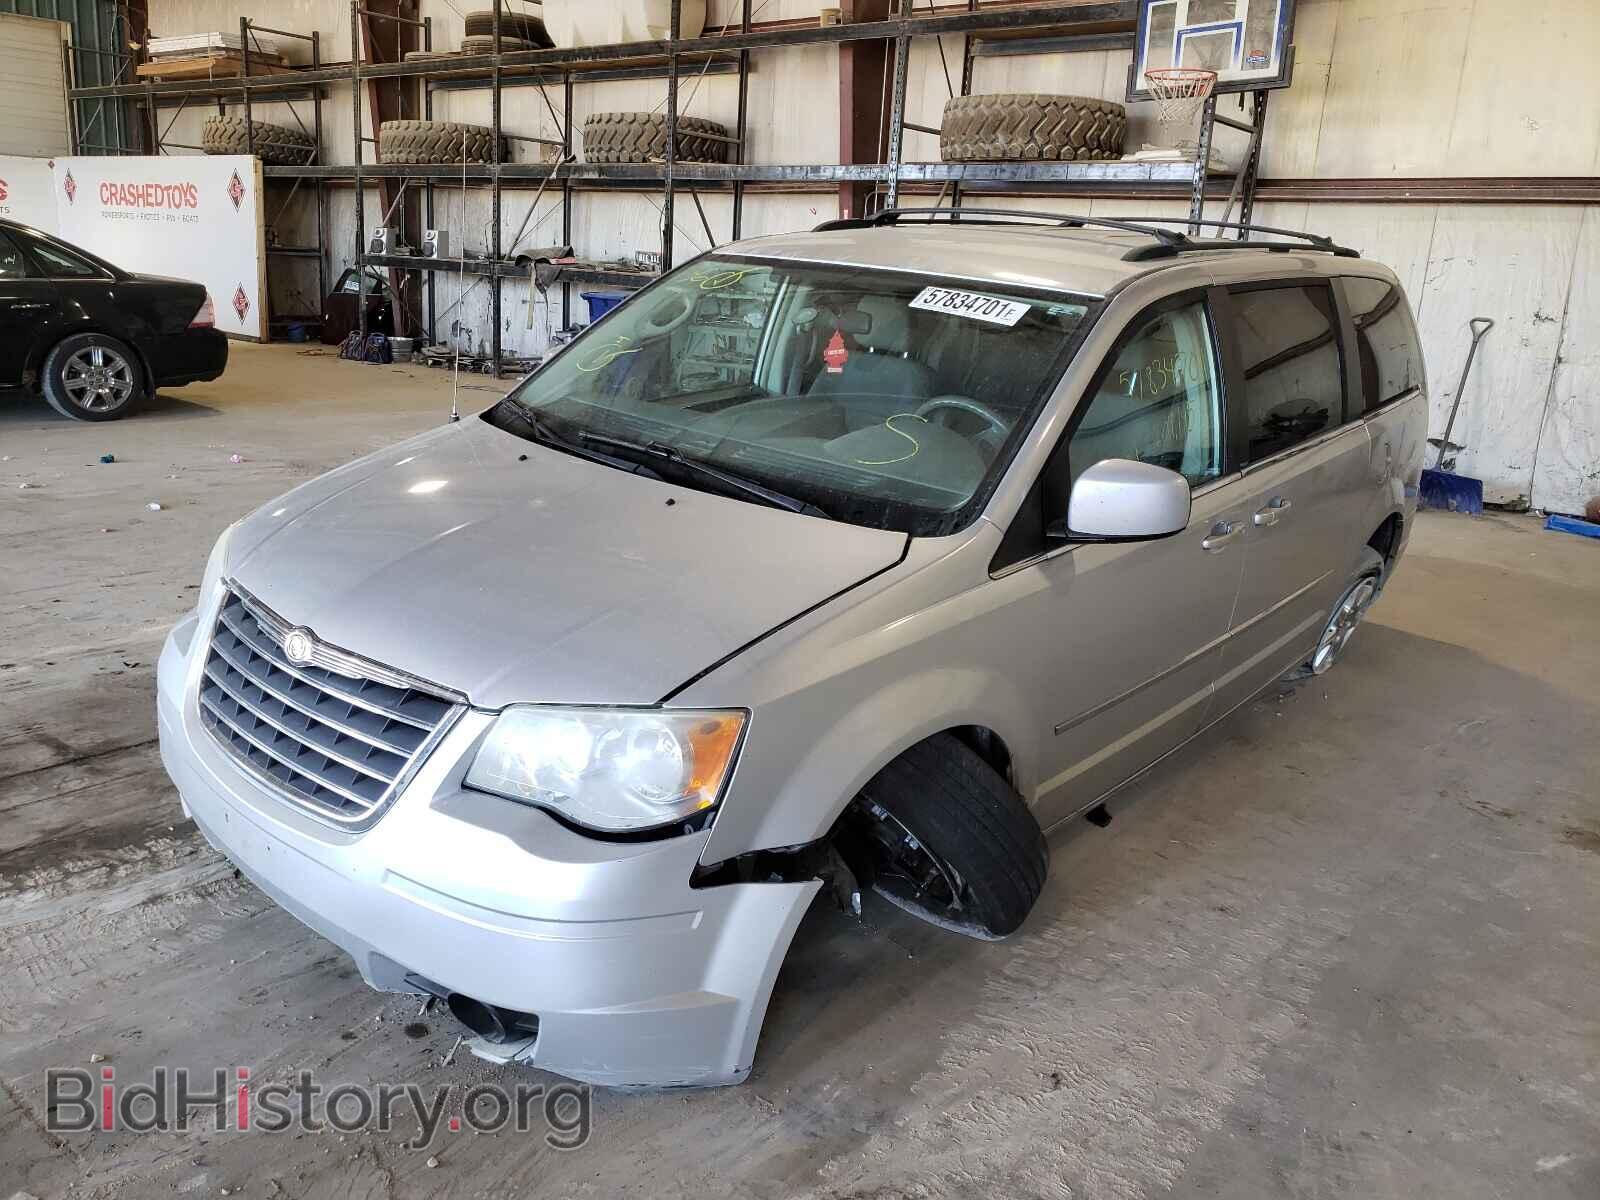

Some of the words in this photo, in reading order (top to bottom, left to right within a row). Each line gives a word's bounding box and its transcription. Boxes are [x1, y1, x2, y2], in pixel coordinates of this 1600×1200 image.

[100, 182, 198, 208] CRASHEDTOYS
[923, 289, 1009, 318] 57834701
[855, 413, 929, 465] S
